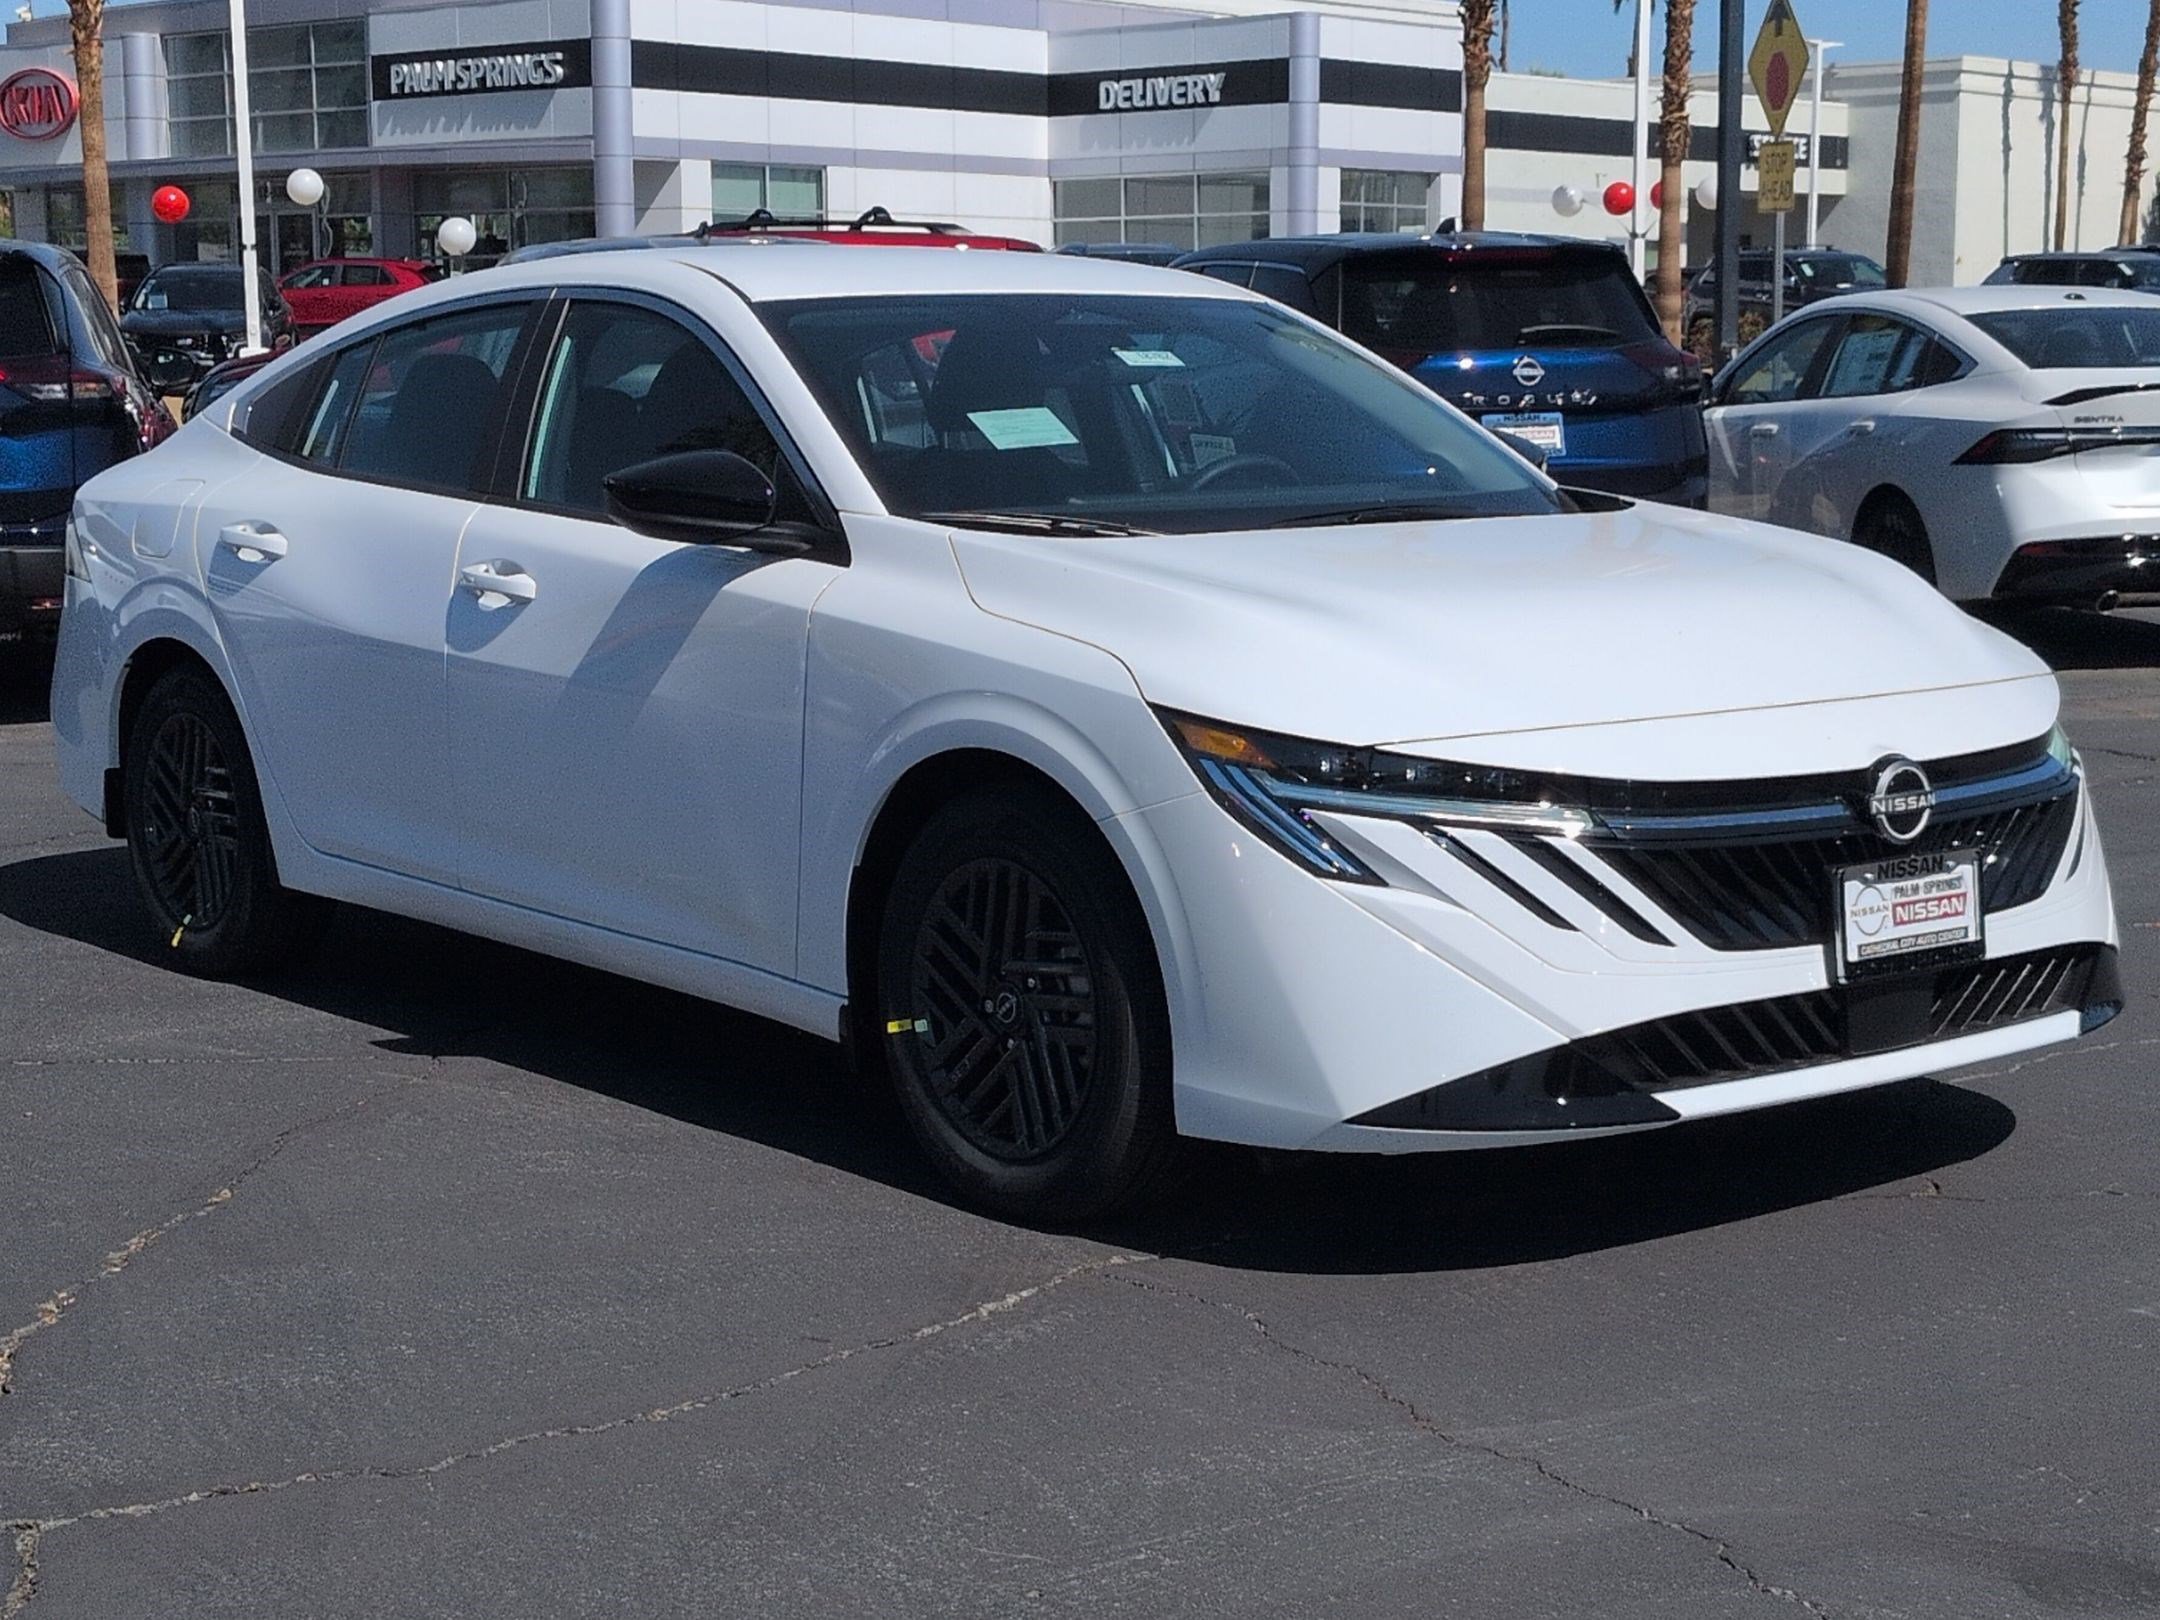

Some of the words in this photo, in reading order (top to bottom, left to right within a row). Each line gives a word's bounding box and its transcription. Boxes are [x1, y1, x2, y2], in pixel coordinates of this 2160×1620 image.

[390, 59, 456, 94] PALM
[456, 52, 565, 90] SPRINGS
[1099, 73, 1226, 110] DELIVERY
[6, 86, 64, 124] KIA
[1764, 152, 1789, 174] STOP
[1760, 178, 1792, 201] AHEAD
[2074, 415, 2125, 424] SENTRA
[1871, 793, 1936, 814] NISSAN
[1877, 856, 1944, 880] NISSAN
[1894, 883, 1920, 899] PALM
[1850, 904, 1889, 919] NISSAN
[1895, 896, 1965, 923] NISSAN
[1900, 937, 1917, 949] CITY
[1917, 934, 1937, 946] AUTO
